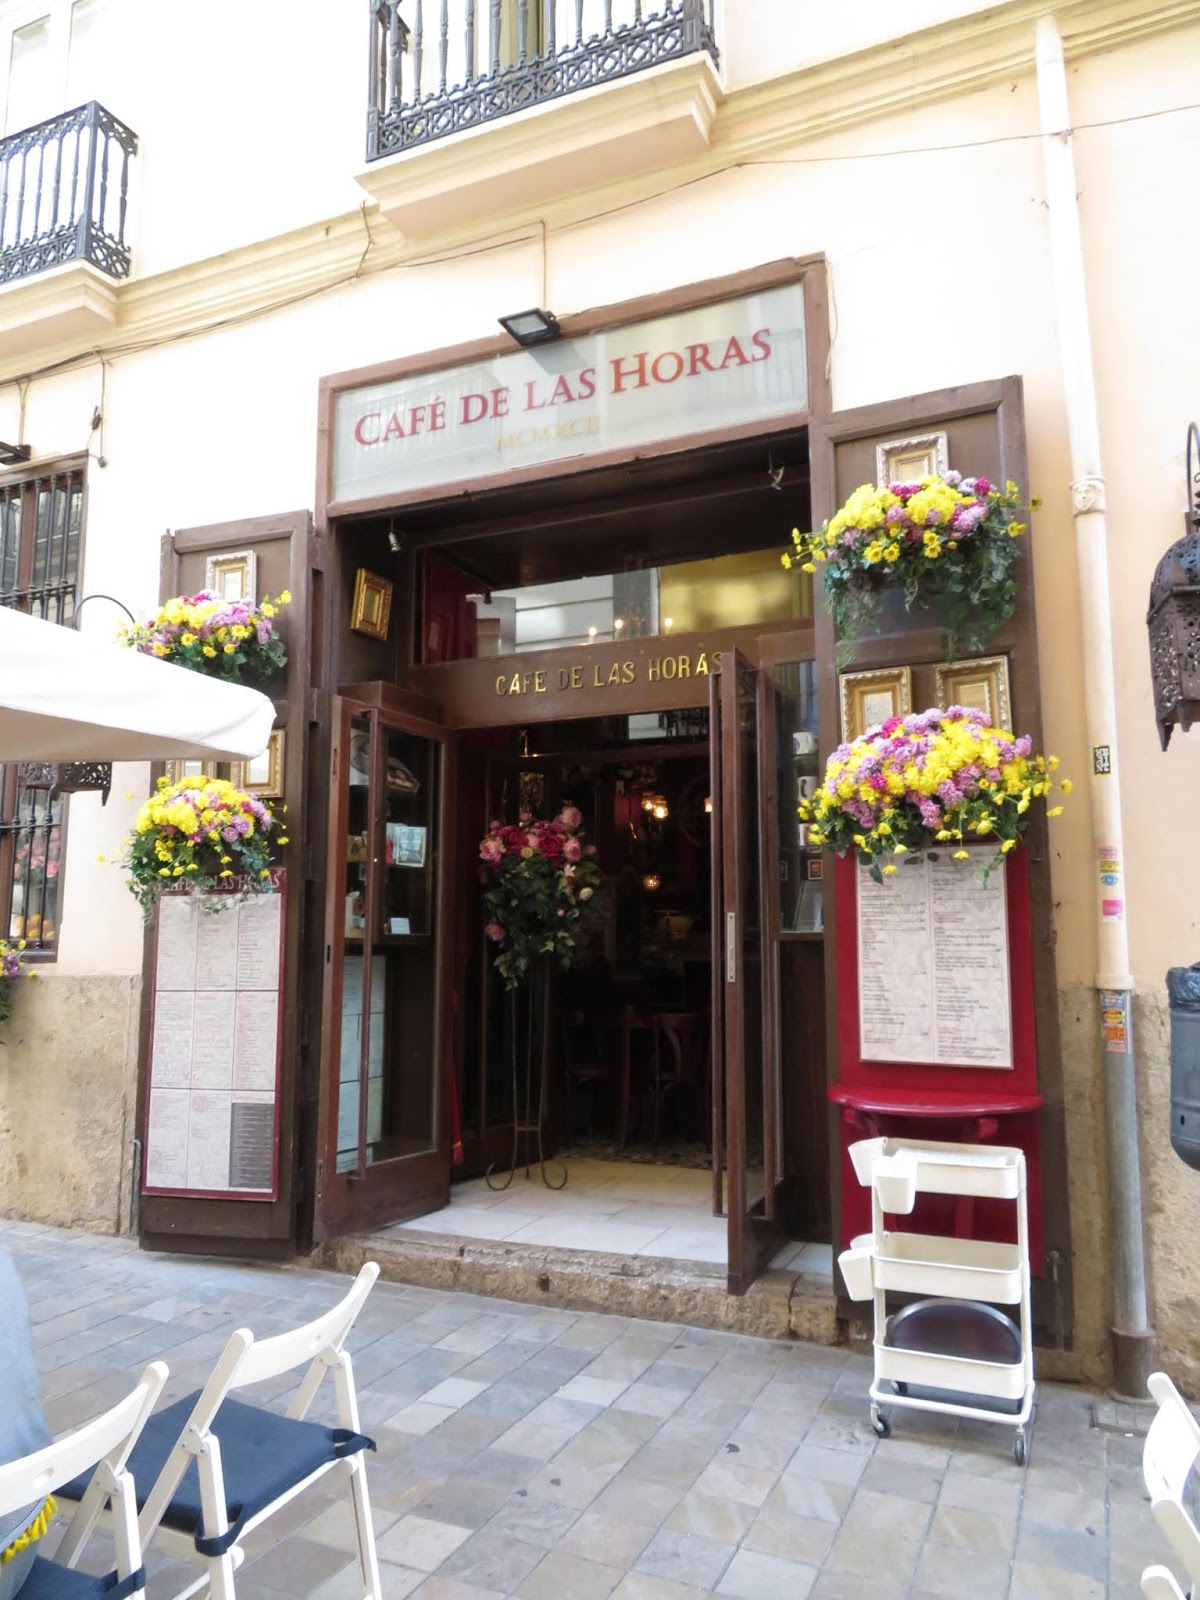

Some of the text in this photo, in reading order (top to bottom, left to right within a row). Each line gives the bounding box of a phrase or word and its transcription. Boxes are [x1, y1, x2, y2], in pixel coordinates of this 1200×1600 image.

[354, 328, 772, 446] CAFÉ DE LAS HORAS
[495, 651, 722, 697] CAFE DE LAS HORAS
[214, 874, 235, 890] LAS
